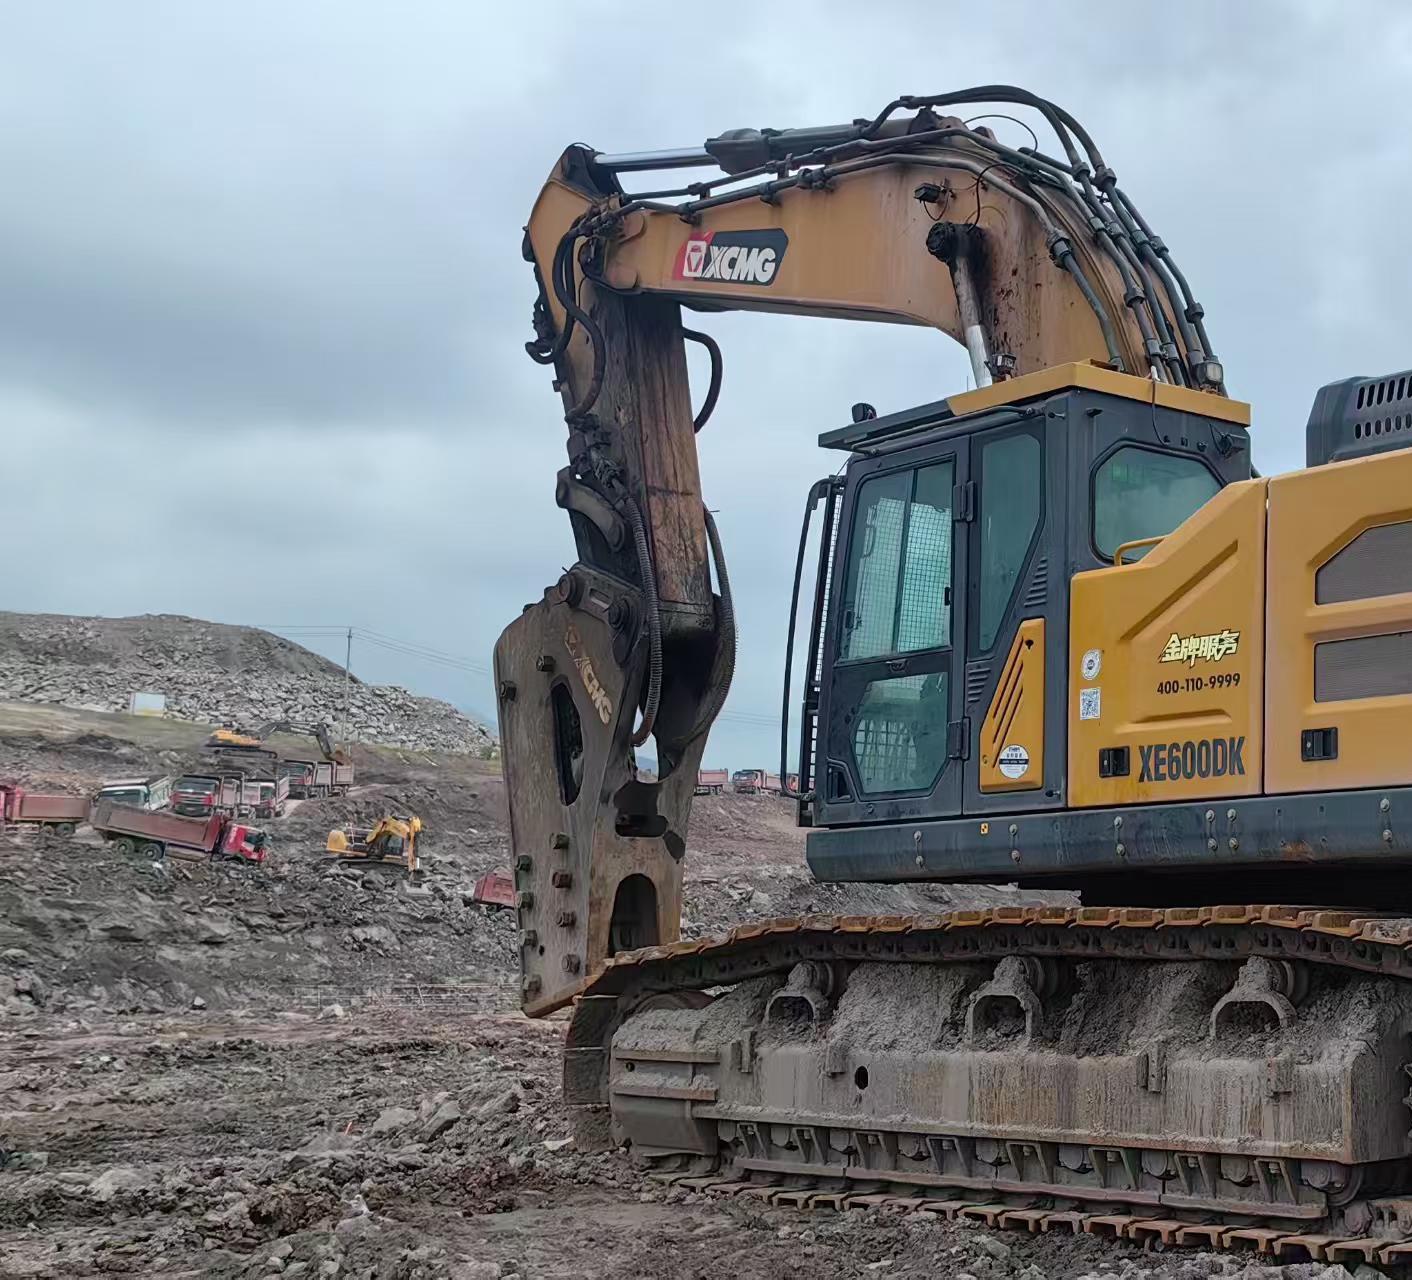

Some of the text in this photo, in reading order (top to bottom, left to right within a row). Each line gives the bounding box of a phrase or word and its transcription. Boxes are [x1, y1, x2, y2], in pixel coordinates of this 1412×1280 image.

[702, 245, 777, 283] XCMG
[1159, 629, 1241, 669] 金牌服务
[1157, 672, 1241, 695] 400-110-9999
[1138, 736, 1246, 783] XE600DK
